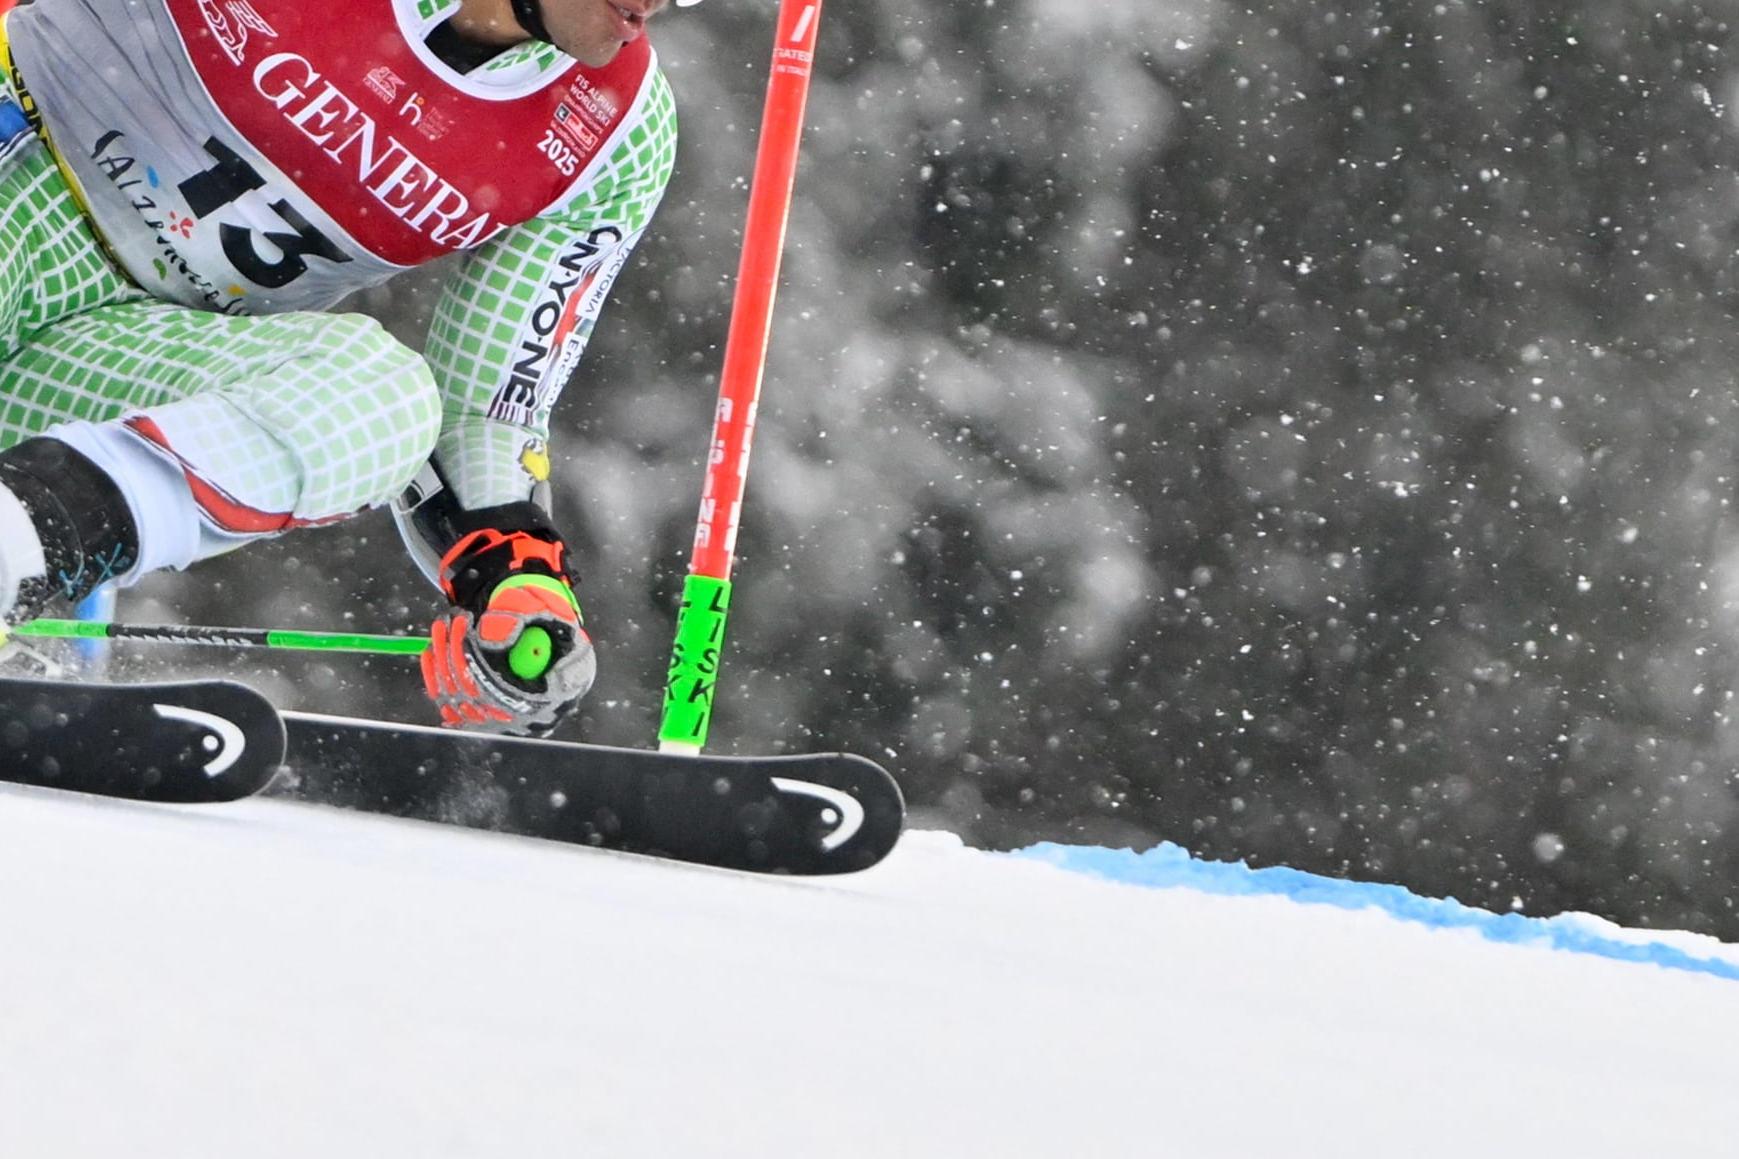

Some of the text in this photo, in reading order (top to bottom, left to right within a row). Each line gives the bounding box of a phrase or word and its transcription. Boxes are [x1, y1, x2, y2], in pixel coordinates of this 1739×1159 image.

[569, 83, 598, 113] WORLD
[596, 110, 611, 127] SKI
[574, 73, 618, 117] FIS ALPINE
[536, 129, 580, 176] 2025
[177, 135, 355, 290] 13
